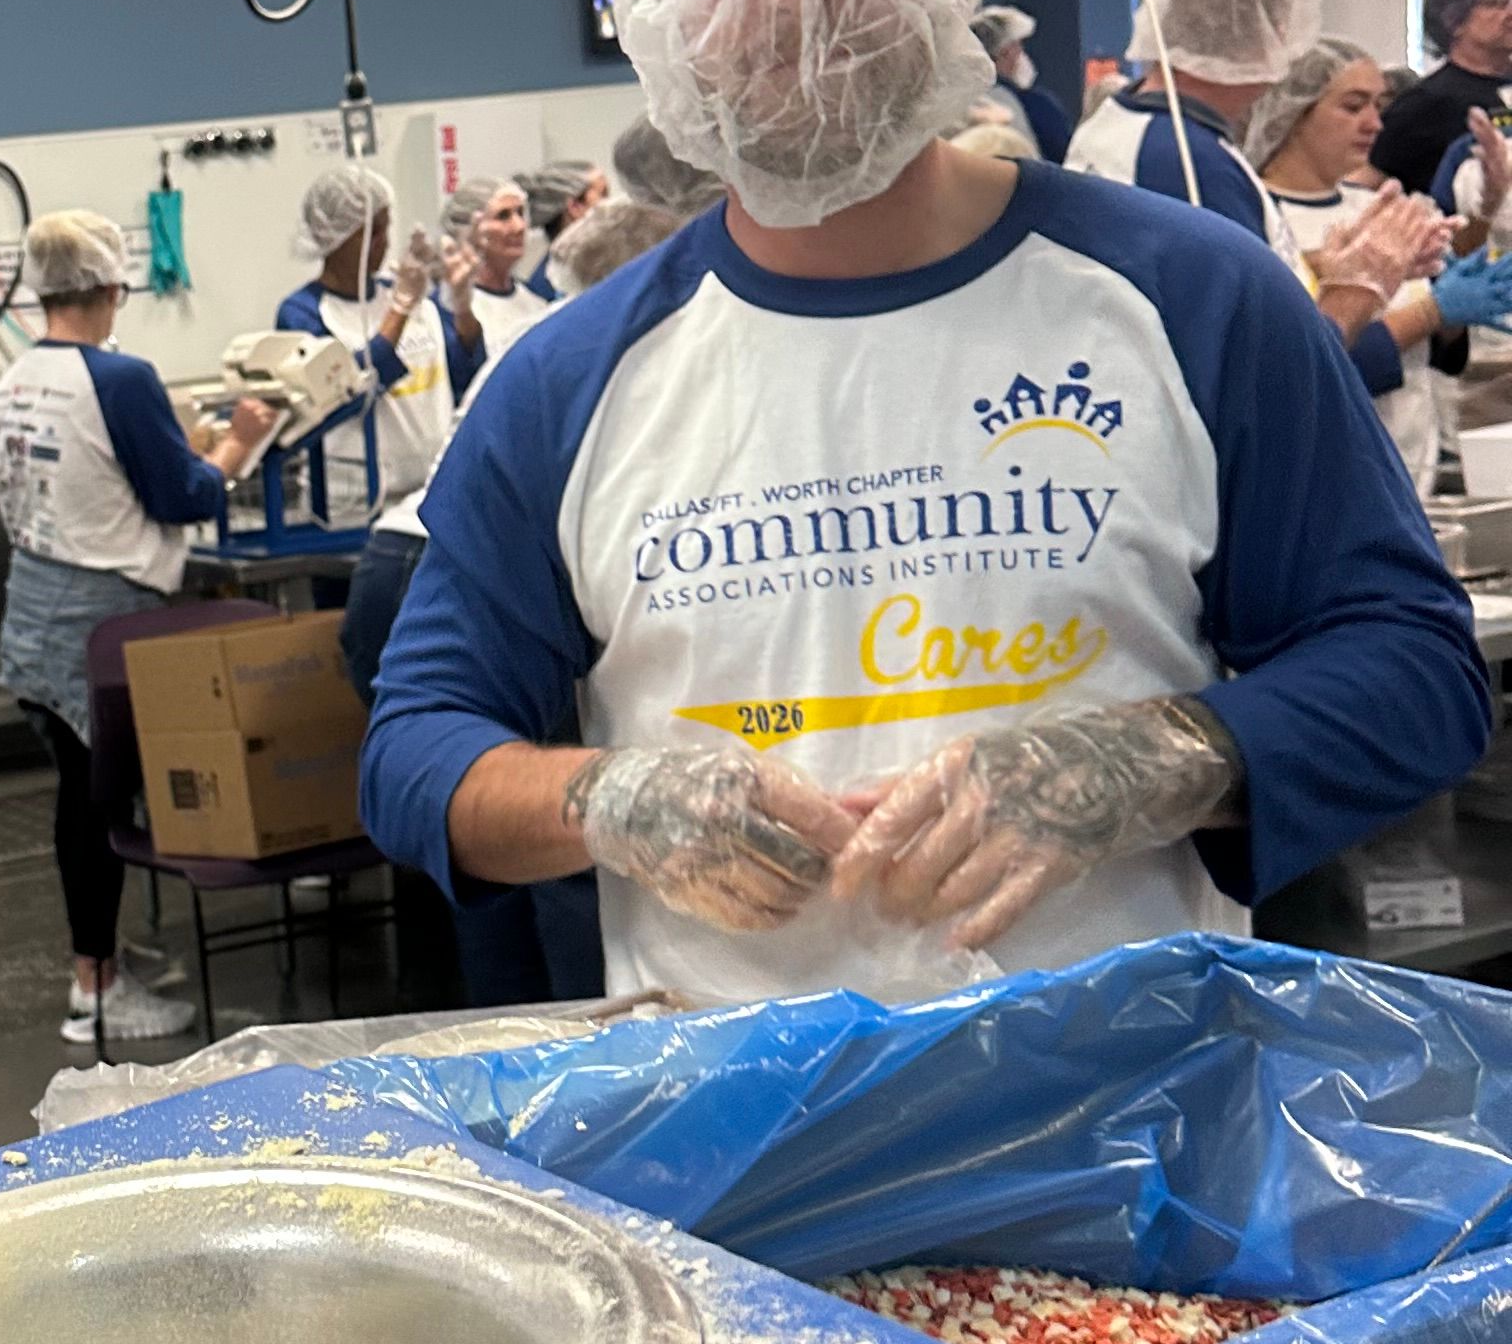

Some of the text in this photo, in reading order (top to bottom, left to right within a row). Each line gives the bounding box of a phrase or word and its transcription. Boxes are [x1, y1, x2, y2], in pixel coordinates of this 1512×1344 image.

[761, 477, 841, 505] WORTH
[846, 464, 945, 496] CHAPTER
[635, 465, 1120, 582] community
[647, 547, 1066, 614] ASSOCIATIONS INSTITUTE
[859, 592, 1081, 686] Cares
[737, 702, 805, 737] 2026
